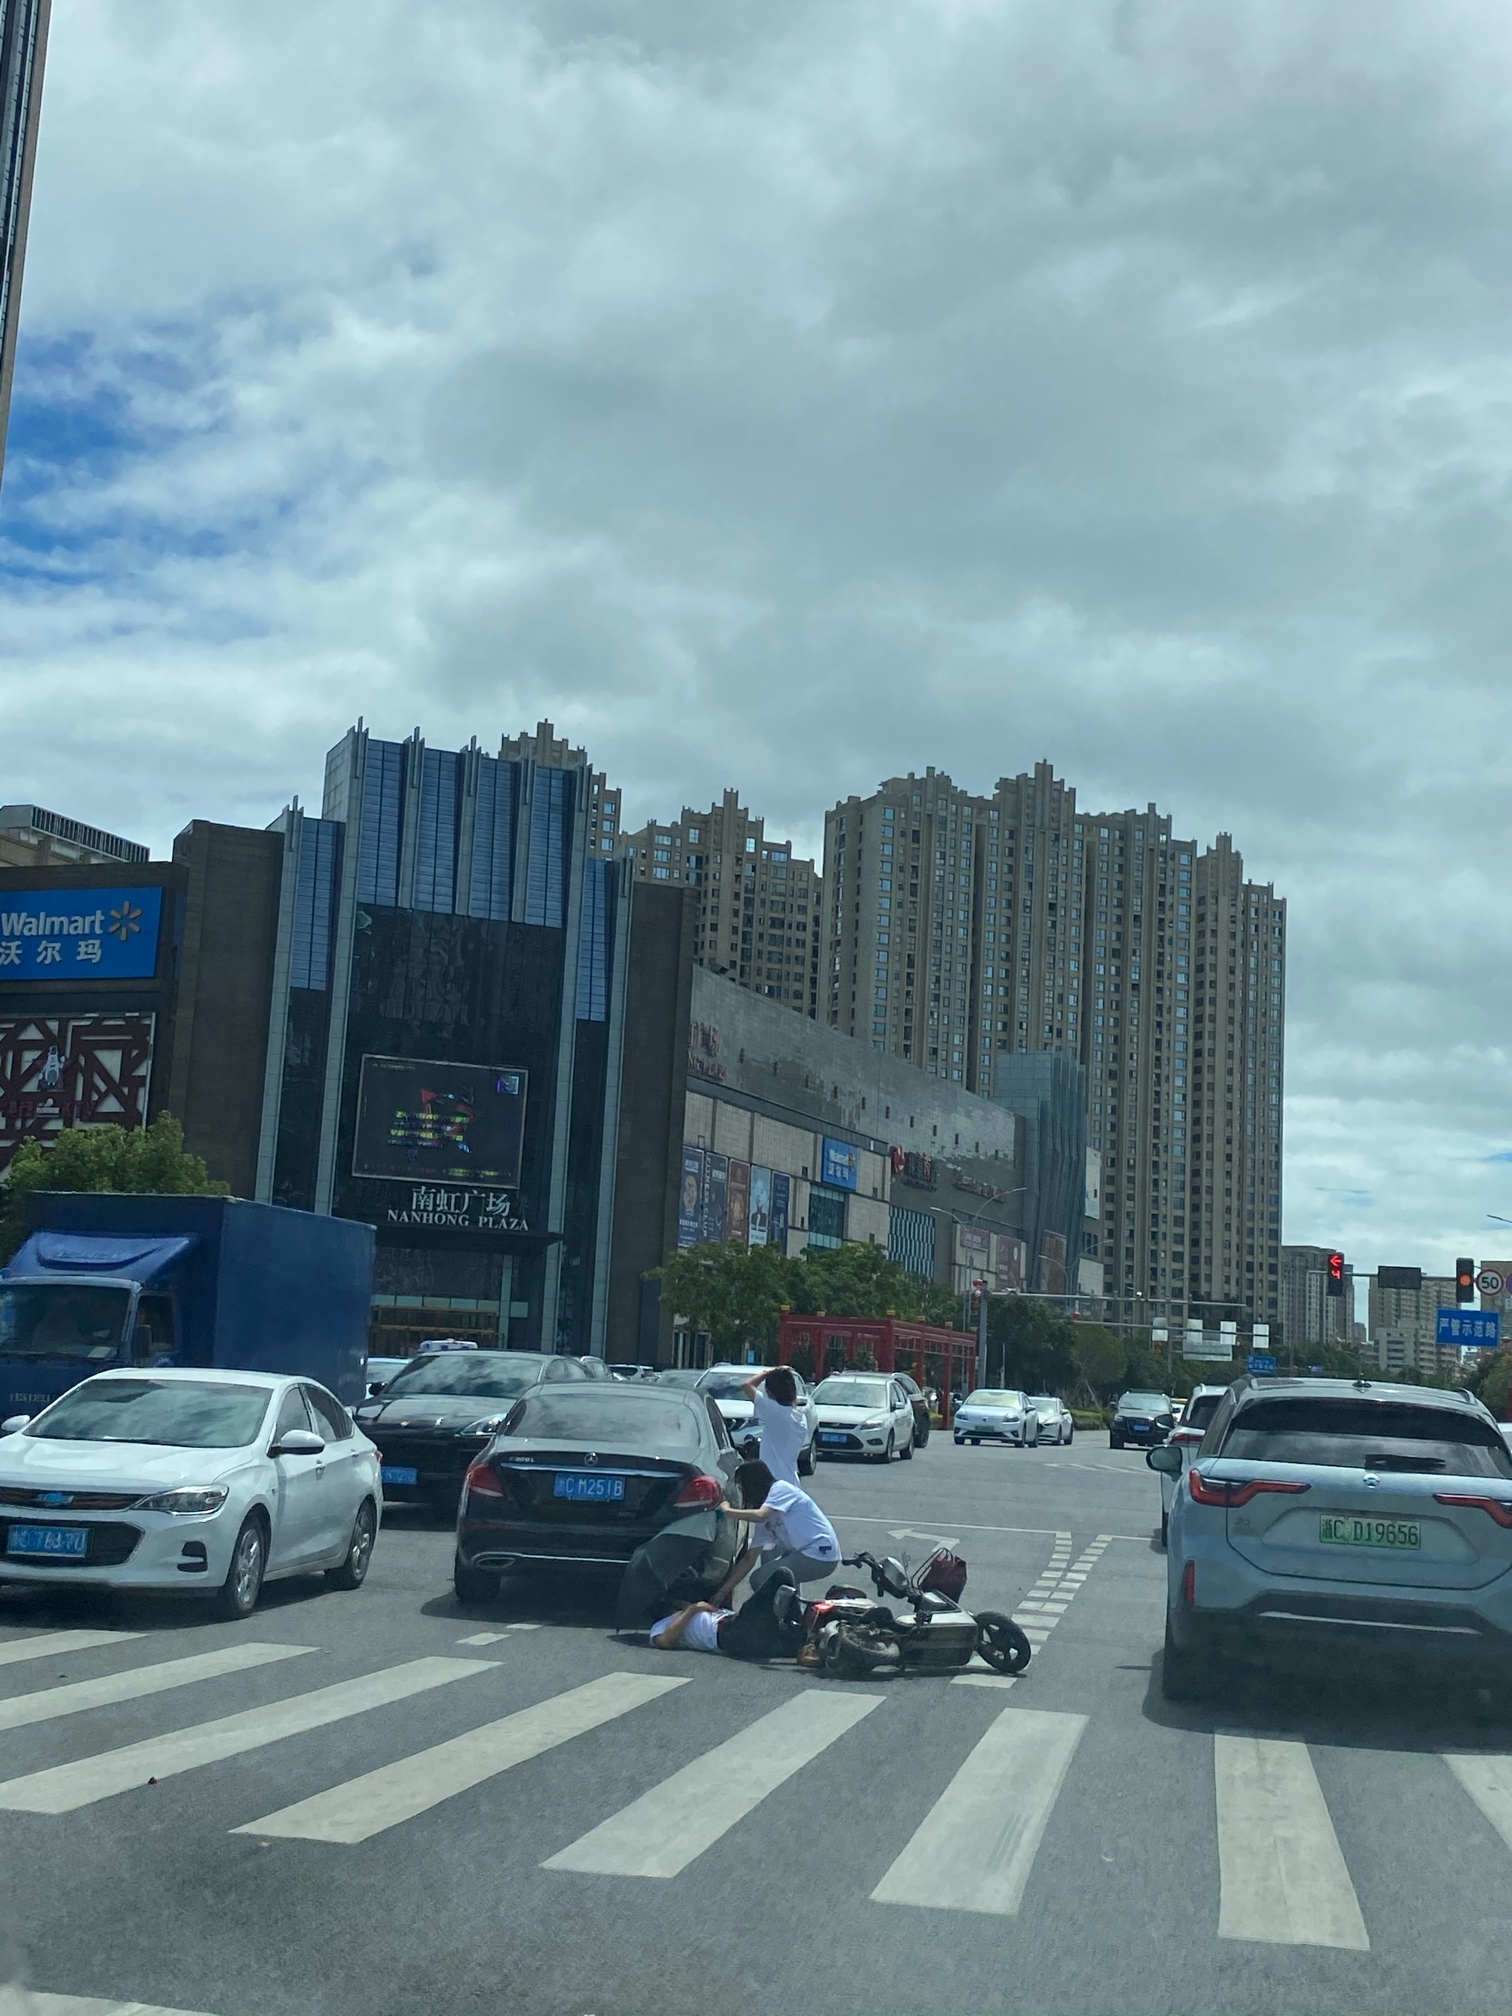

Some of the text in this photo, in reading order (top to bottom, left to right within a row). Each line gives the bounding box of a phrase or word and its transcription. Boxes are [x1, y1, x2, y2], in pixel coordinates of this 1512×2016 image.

[1, 909, 105, 936] Walmart
[0, 938, 102, 965] 沃尔玛
[411, 1185, 510, 1217] 南虹广场
[387, 1209, 529, 1231] NANHONG PLAZA
[1481, 1276, 1499, 1290] 50
[1438, 1317, 1497, 1339] 严管示范路
